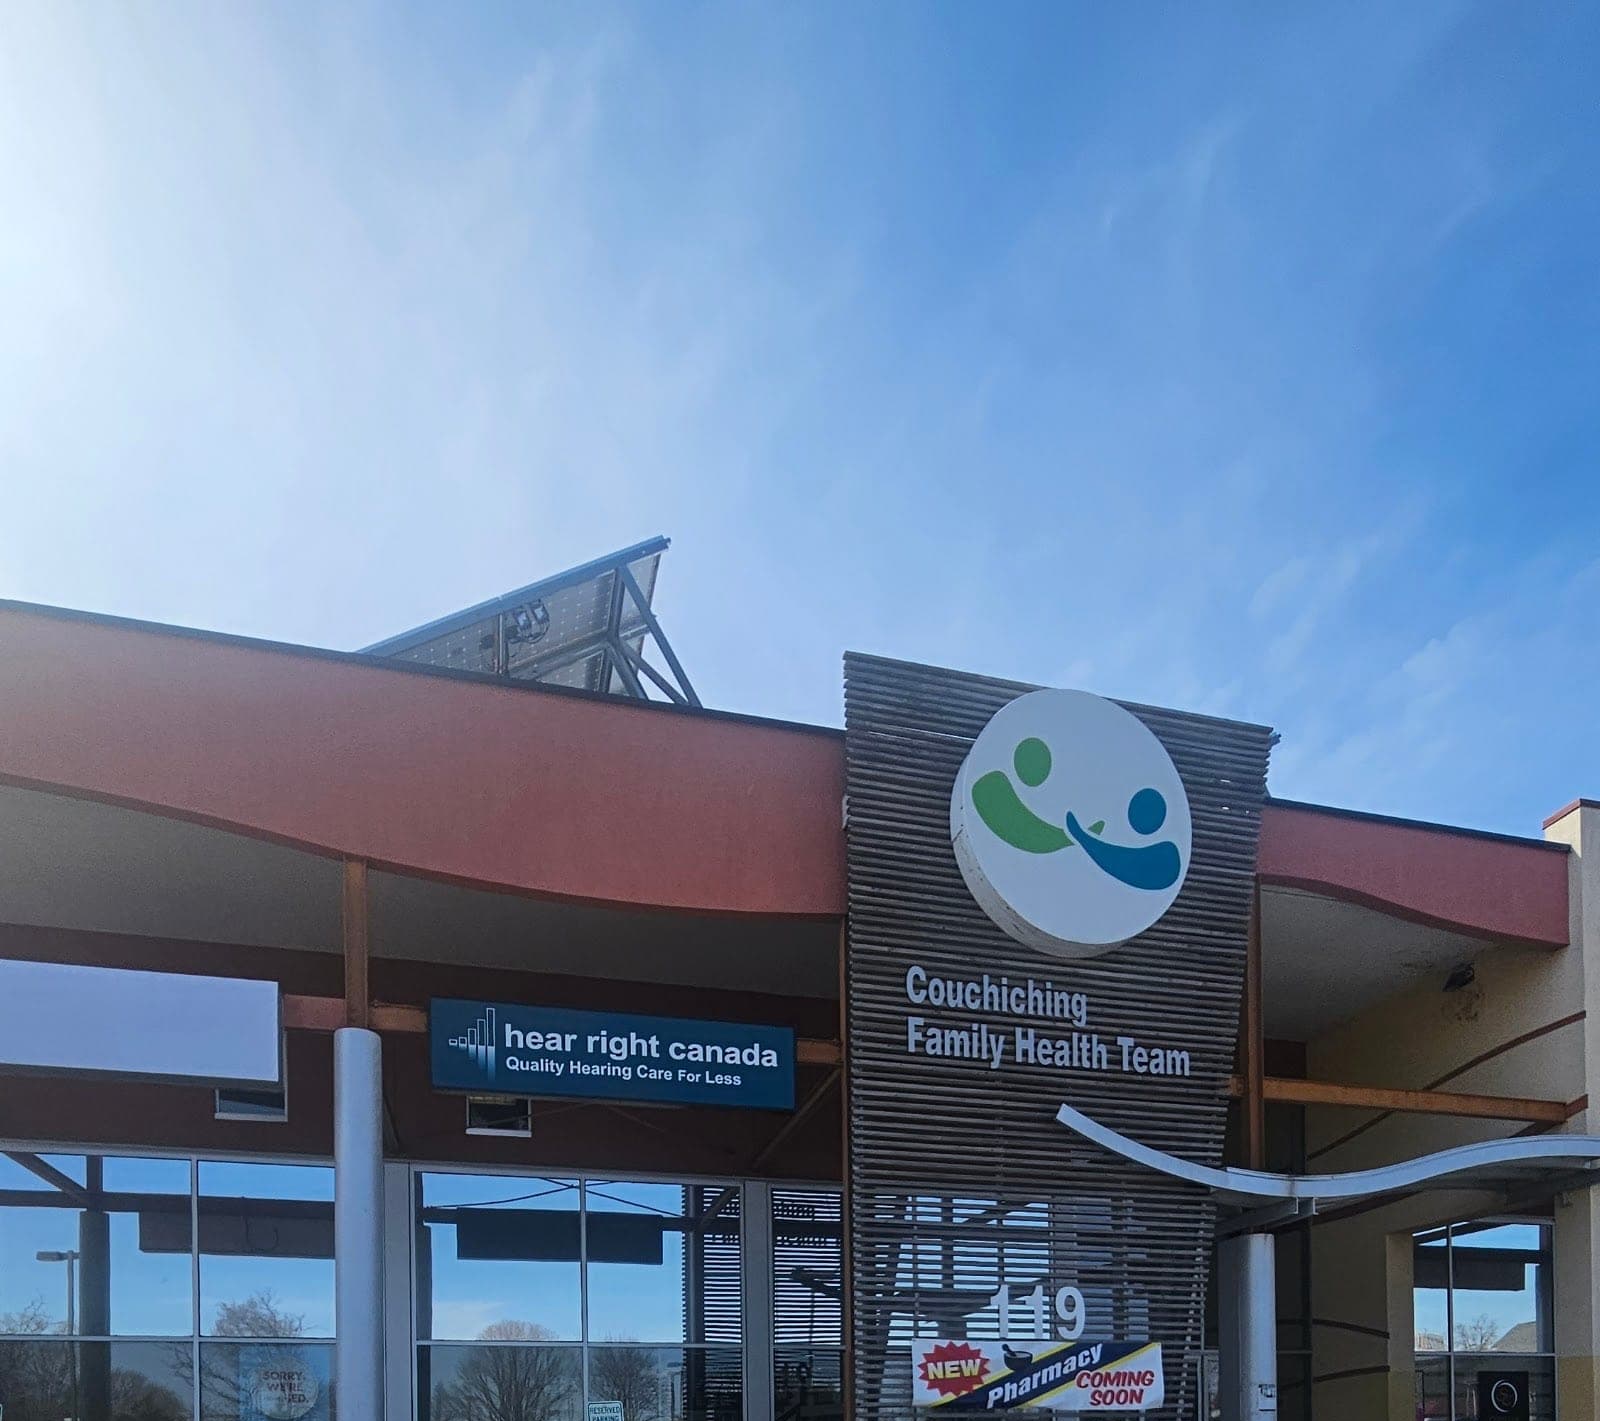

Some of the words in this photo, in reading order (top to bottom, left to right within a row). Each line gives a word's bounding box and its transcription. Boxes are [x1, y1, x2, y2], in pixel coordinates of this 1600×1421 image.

[906, 965, 1087, 1027] Couchiching
[504, 1023, 577, 1051] hear
[586, 1030, 660, 1060] right
[668, 1043, 778, 1068] canada
[907, 1016, 1005, 1069] Family
[1015, 1026, 1108, 1070] Health
[1117, 1036, 1190, 1076] Team
[505, 1057, 565, 1077] Quality
[569, 1060, 632, 1080] Hearing
[636, 1066, 673, 1081] Care
[677, 1069, 702, 1083] For
[705, 1071, 742, 1086] Less
[990, 1284, 1086, 1340] 119
[927, 1358, 981, 1380] NEW
[986, 1343, 1103, 1409] Pharmacy
[1075, 1369, 1155, 1389] COMING
[1089, 1388, 1144, 1406] SOON
